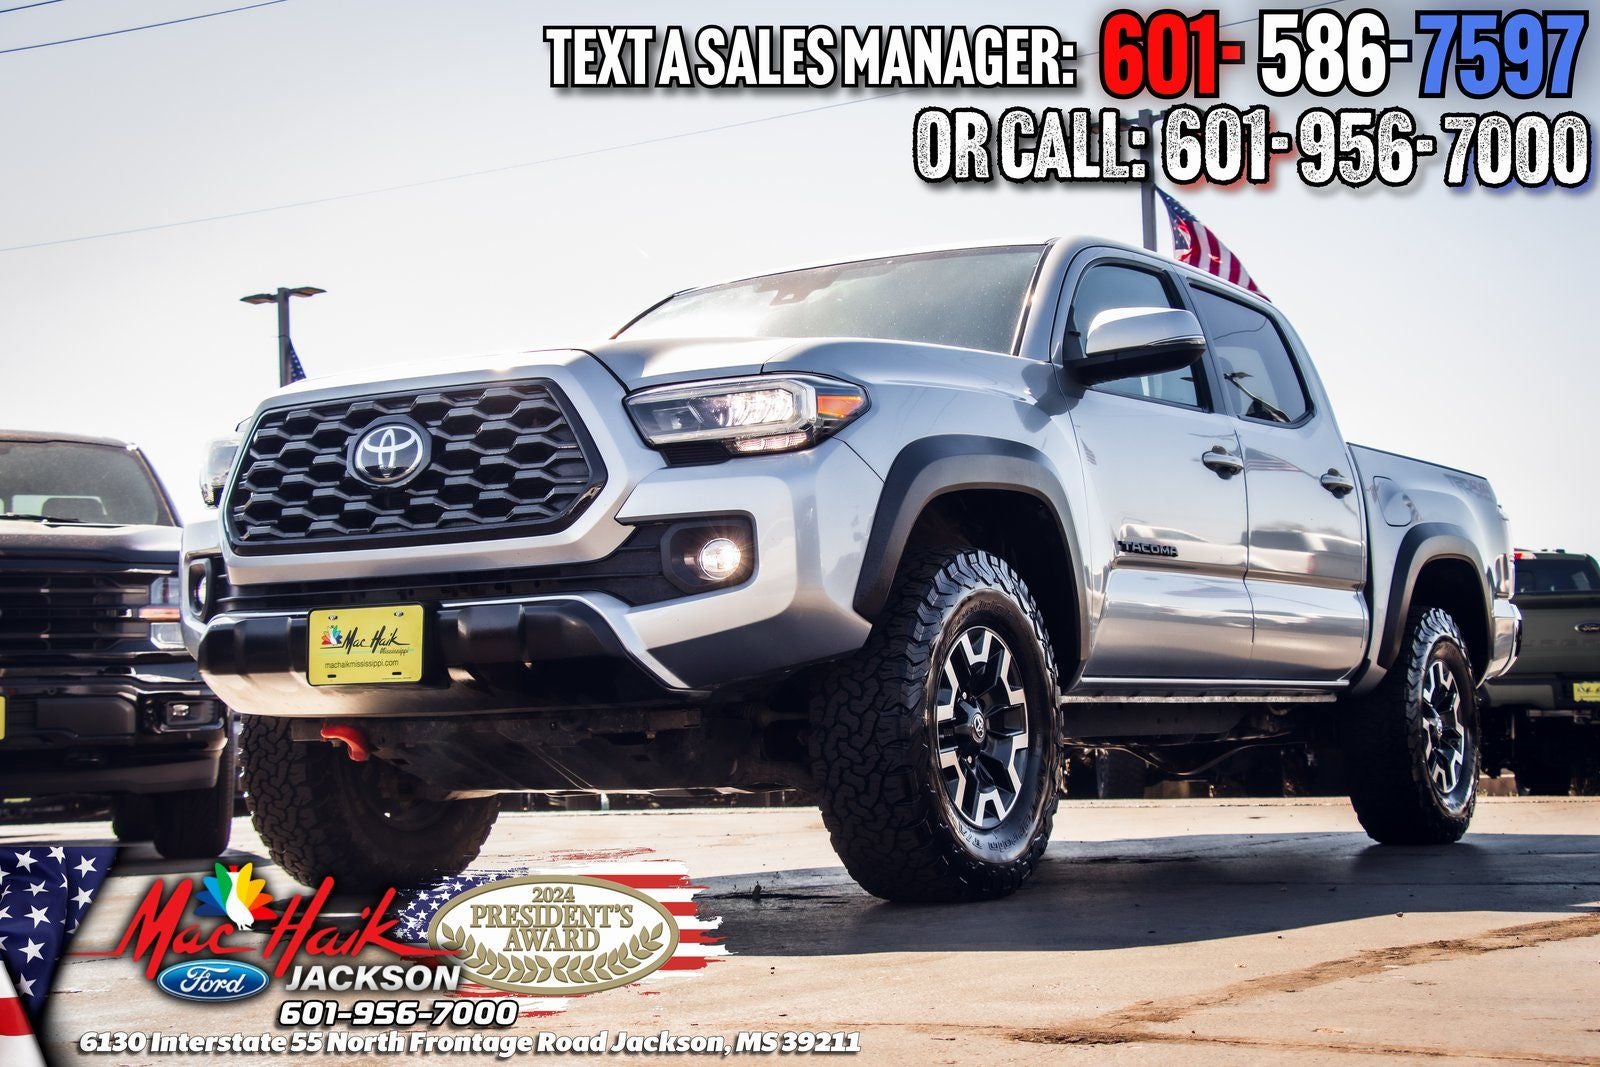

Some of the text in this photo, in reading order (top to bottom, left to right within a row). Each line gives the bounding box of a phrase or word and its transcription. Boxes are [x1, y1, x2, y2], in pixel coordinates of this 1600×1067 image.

[1124, 541, 1179, 557] TACOMA
[341, 625, 410, 655] Mac Haik
[380, 647, 409, 656] Mississippi
[324, 659, 399, 669] machaikmississippi.com
